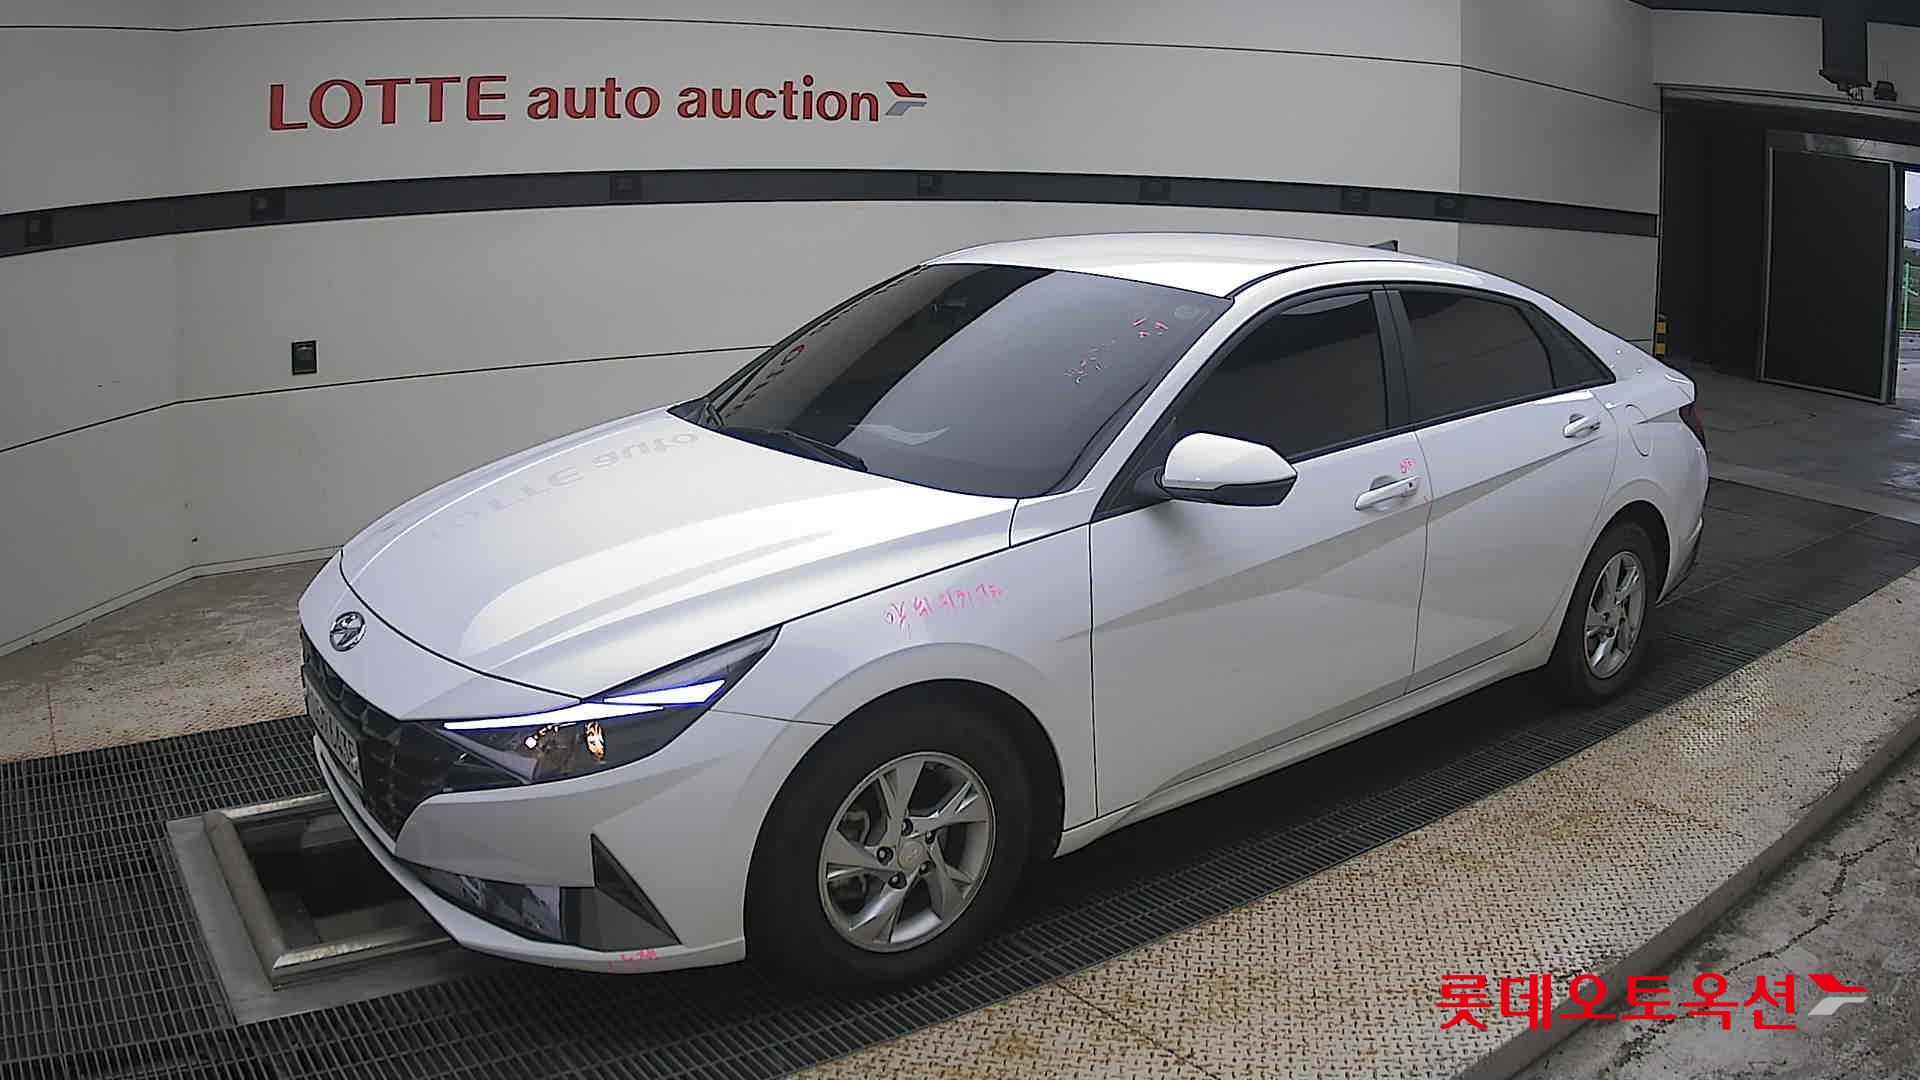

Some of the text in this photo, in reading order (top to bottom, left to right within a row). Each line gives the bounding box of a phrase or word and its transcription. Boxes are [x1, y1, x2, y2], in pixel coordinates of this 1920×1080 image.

[270, 75, 880, 130] LOTTE auto auction
